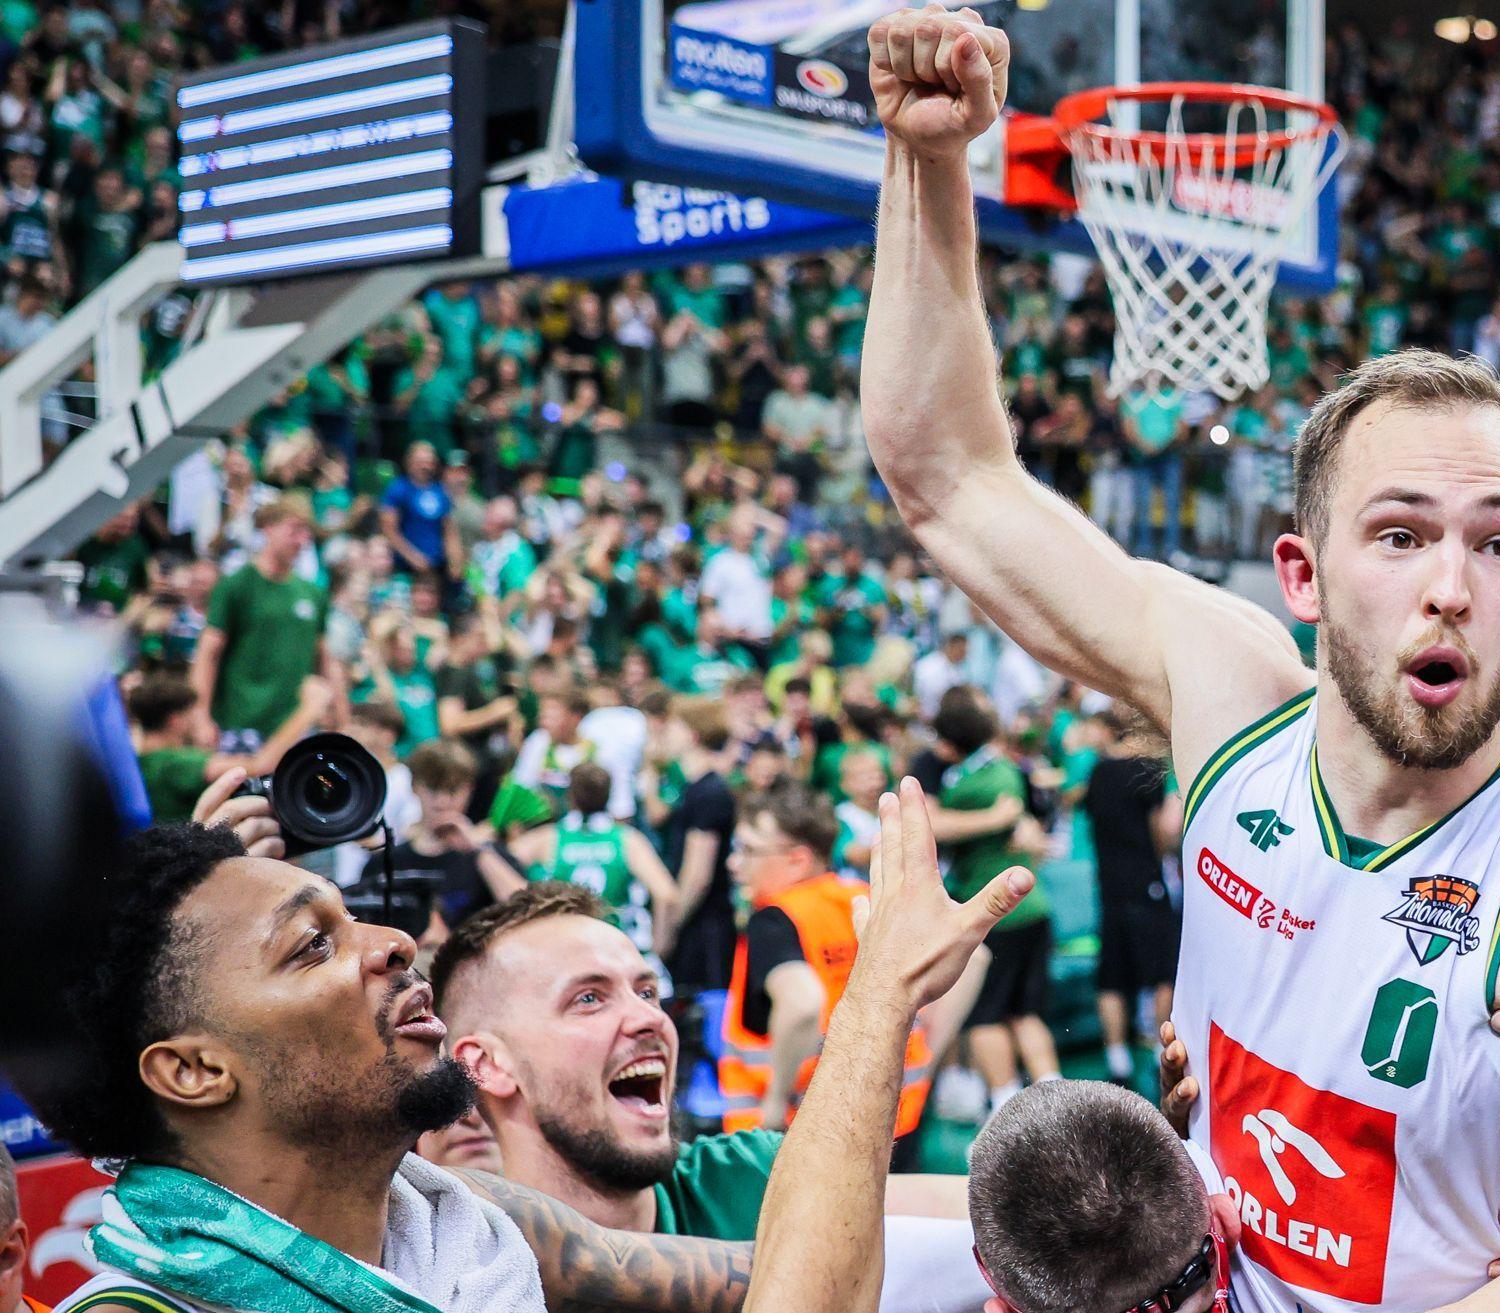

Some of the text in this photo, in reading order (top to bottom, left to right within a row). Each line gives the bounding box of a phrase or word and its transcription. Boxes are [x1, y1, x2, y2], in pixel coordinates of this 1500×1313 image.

[675, 36, 767, 80] molten
[634, 196, 771, 246] Sports
[1236, 808, 1295, 853] 4F
[1201, 856, 1253, 909] ORLEN
[1281, 908, 1316, 930] Bsket
[1224, 1176, 1352, 1268] ORLEN
